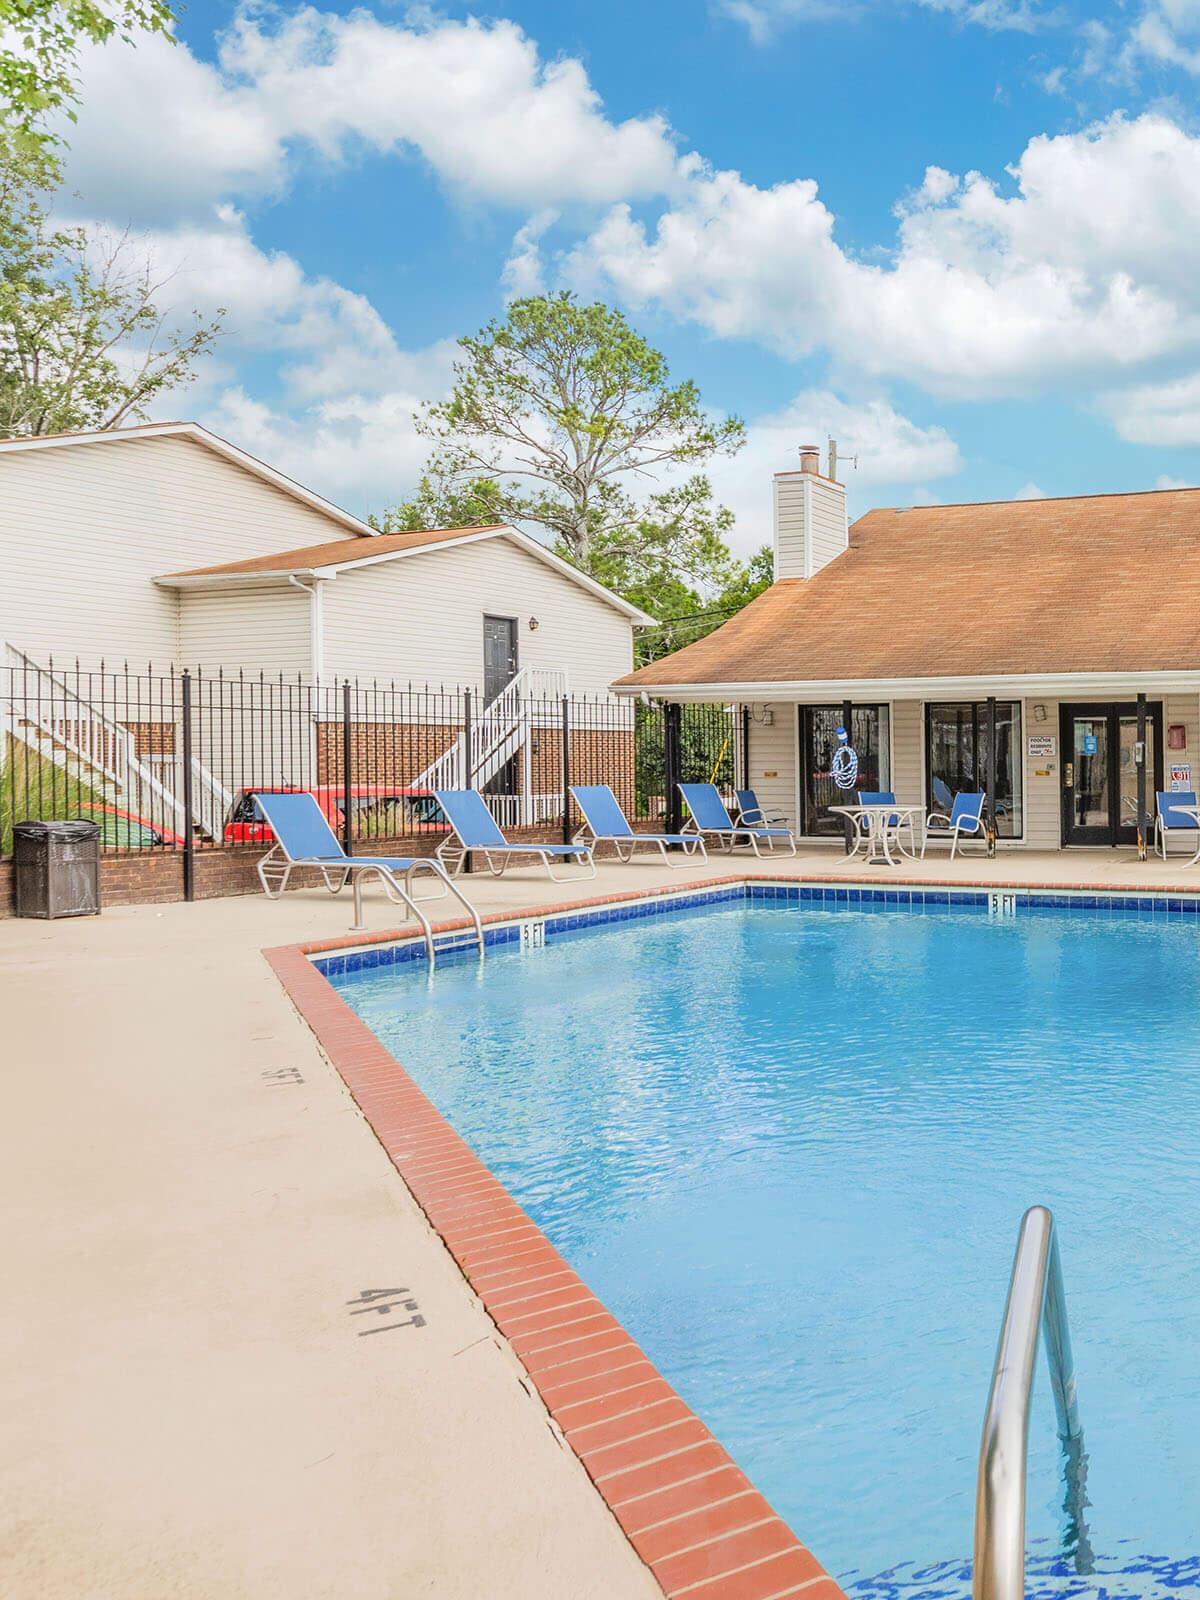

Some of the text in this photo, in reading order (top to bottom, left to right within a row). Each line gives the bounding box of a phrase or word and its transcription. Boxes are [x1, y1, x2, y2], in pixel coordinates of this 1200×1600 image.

[1178, 772, 1190, 780] 911
[524, 922, 543, 943] 5 FT
